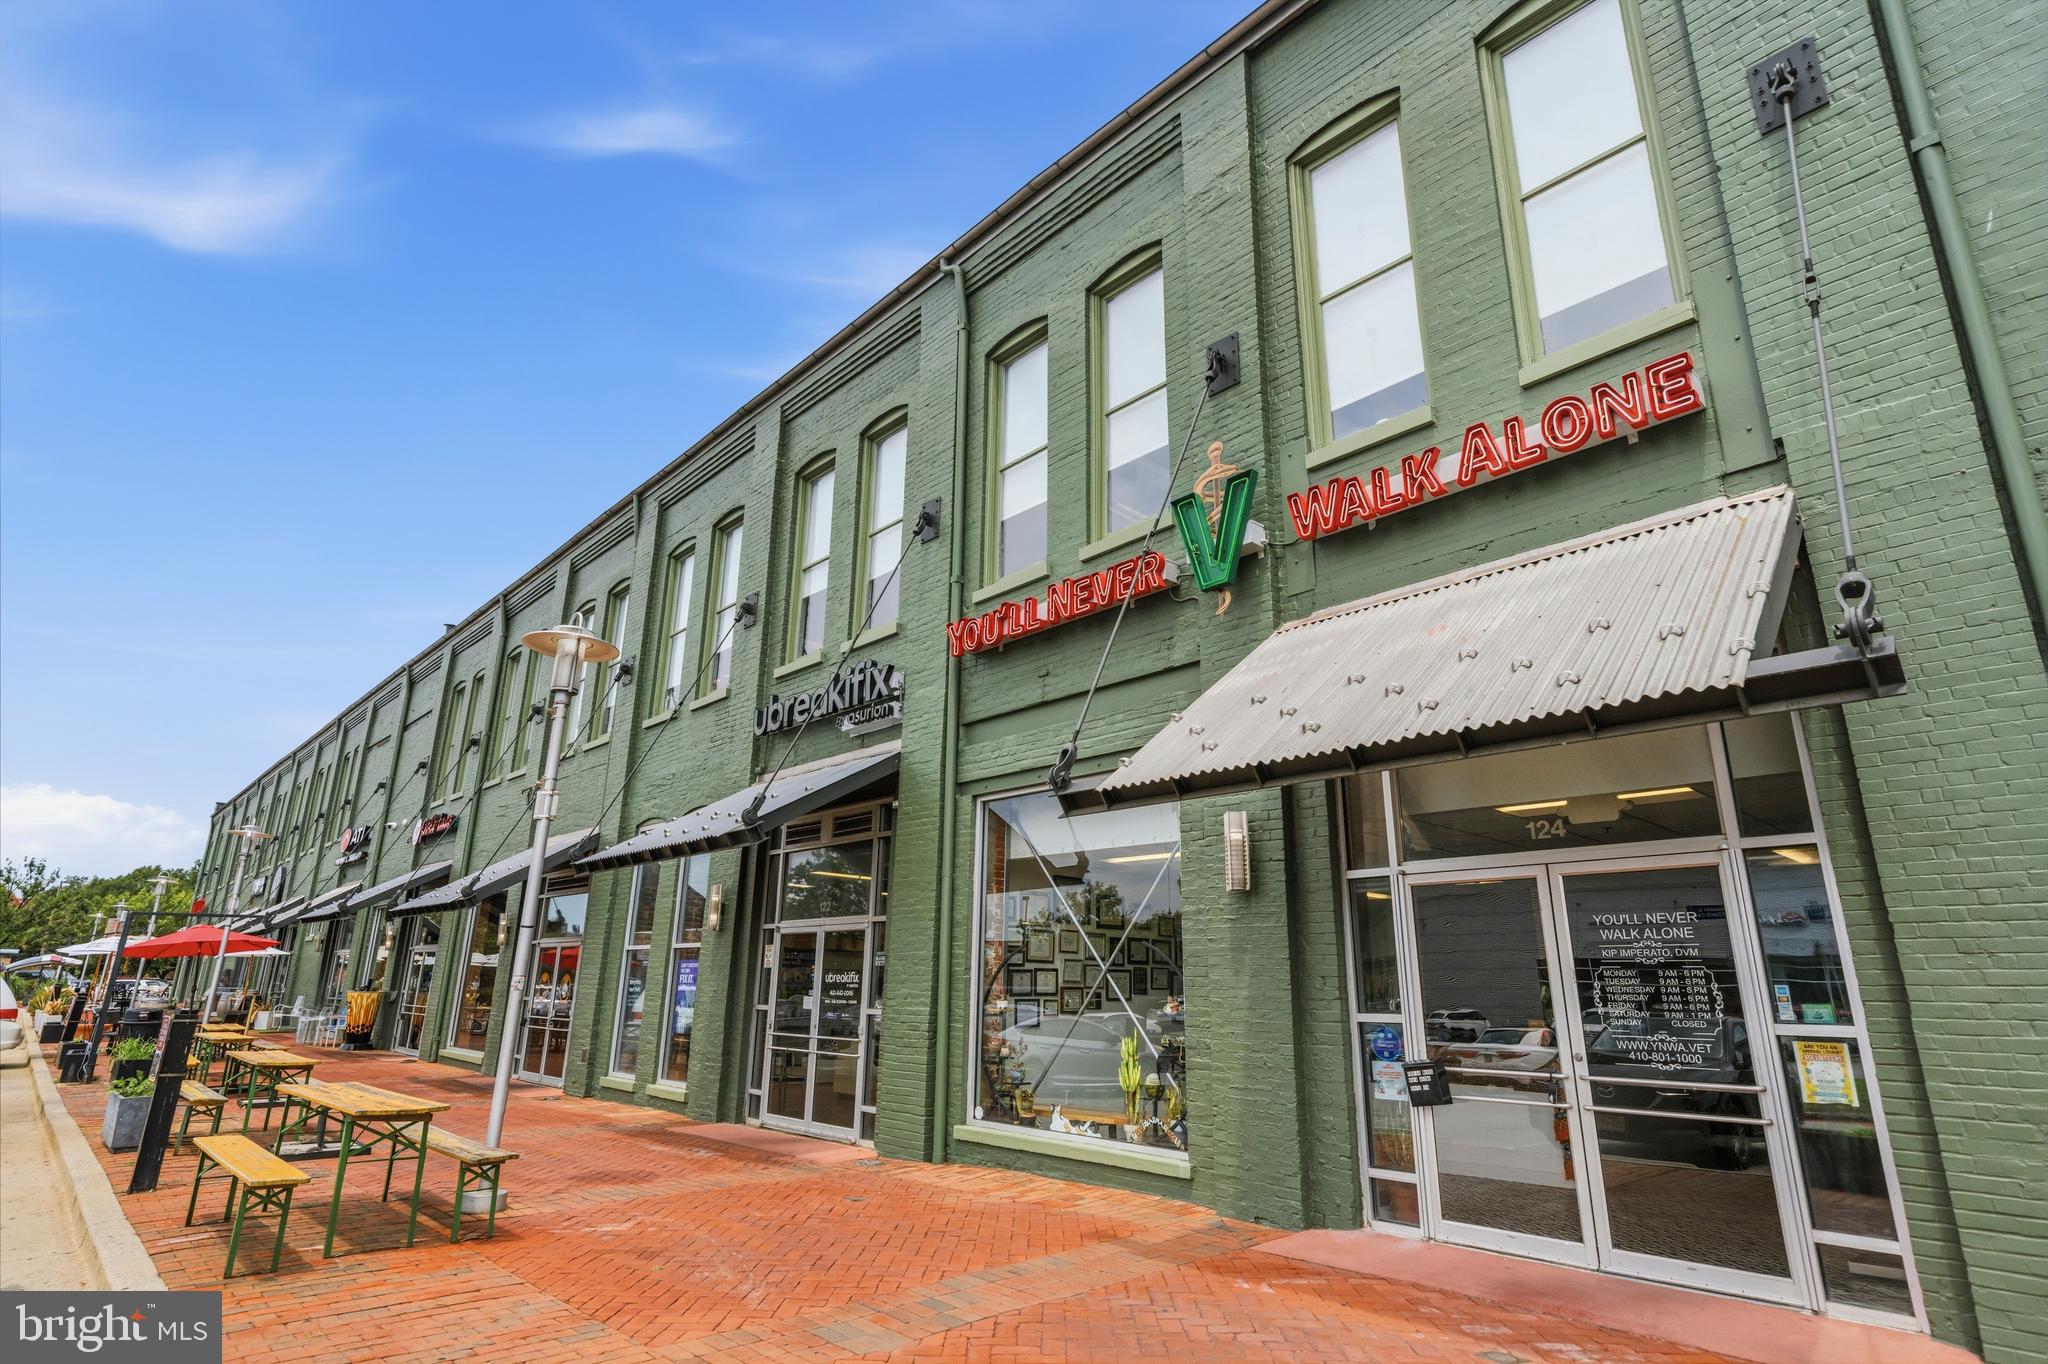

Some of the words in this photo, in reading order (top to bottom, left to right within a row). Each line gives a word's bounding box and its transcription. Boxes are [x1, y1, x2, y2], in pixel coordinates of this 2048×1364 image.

[1287, 446, 1448, 541] WALK
[1456, 351, 1703, 487] ALONE
[1171, 468, 1254, 592] V
[946, 597, 1042, 657] YOU'LL
[1047, 551, 1166, 624] NEVER
[753, 659, 894, 736] ubreakifix
[847, 701, 889, 724] asurion
[1525, 818, 1567, 840] 124
[1592, 913, 1643, 926] YOU'LL
[1645, 911, 1699, 924] NEVER
[1599, 928, 1641, 940] WALK
[1643, 926, 1695, 939] ALONE
[1601, 949, 1618, 957] KIP
[1619, 948, 1673, 957] IMPERATO,
[1675, 948, 1699, 957] DVM
[825, 971, 860, 983] ubreakifix
[1603, 977, 1640, 985] TUESDAY
[1607, 1001, 1636, 1009] FRIDAY
[1696, 1003, 1710, 1011] PM
[1609, 1010, 1650, 1018] SATURDAY
[1697, 1012, 1712, 1020] PM
[1610, 1018, 1642, 1026] SUNDAY
[1671, 1020, 1707, 1028] CLOSED
[1616, 1040, 1712, 1053] WWW.YNWA.VET
[1629, 1051, 1702, 1064] 410-801-1000
